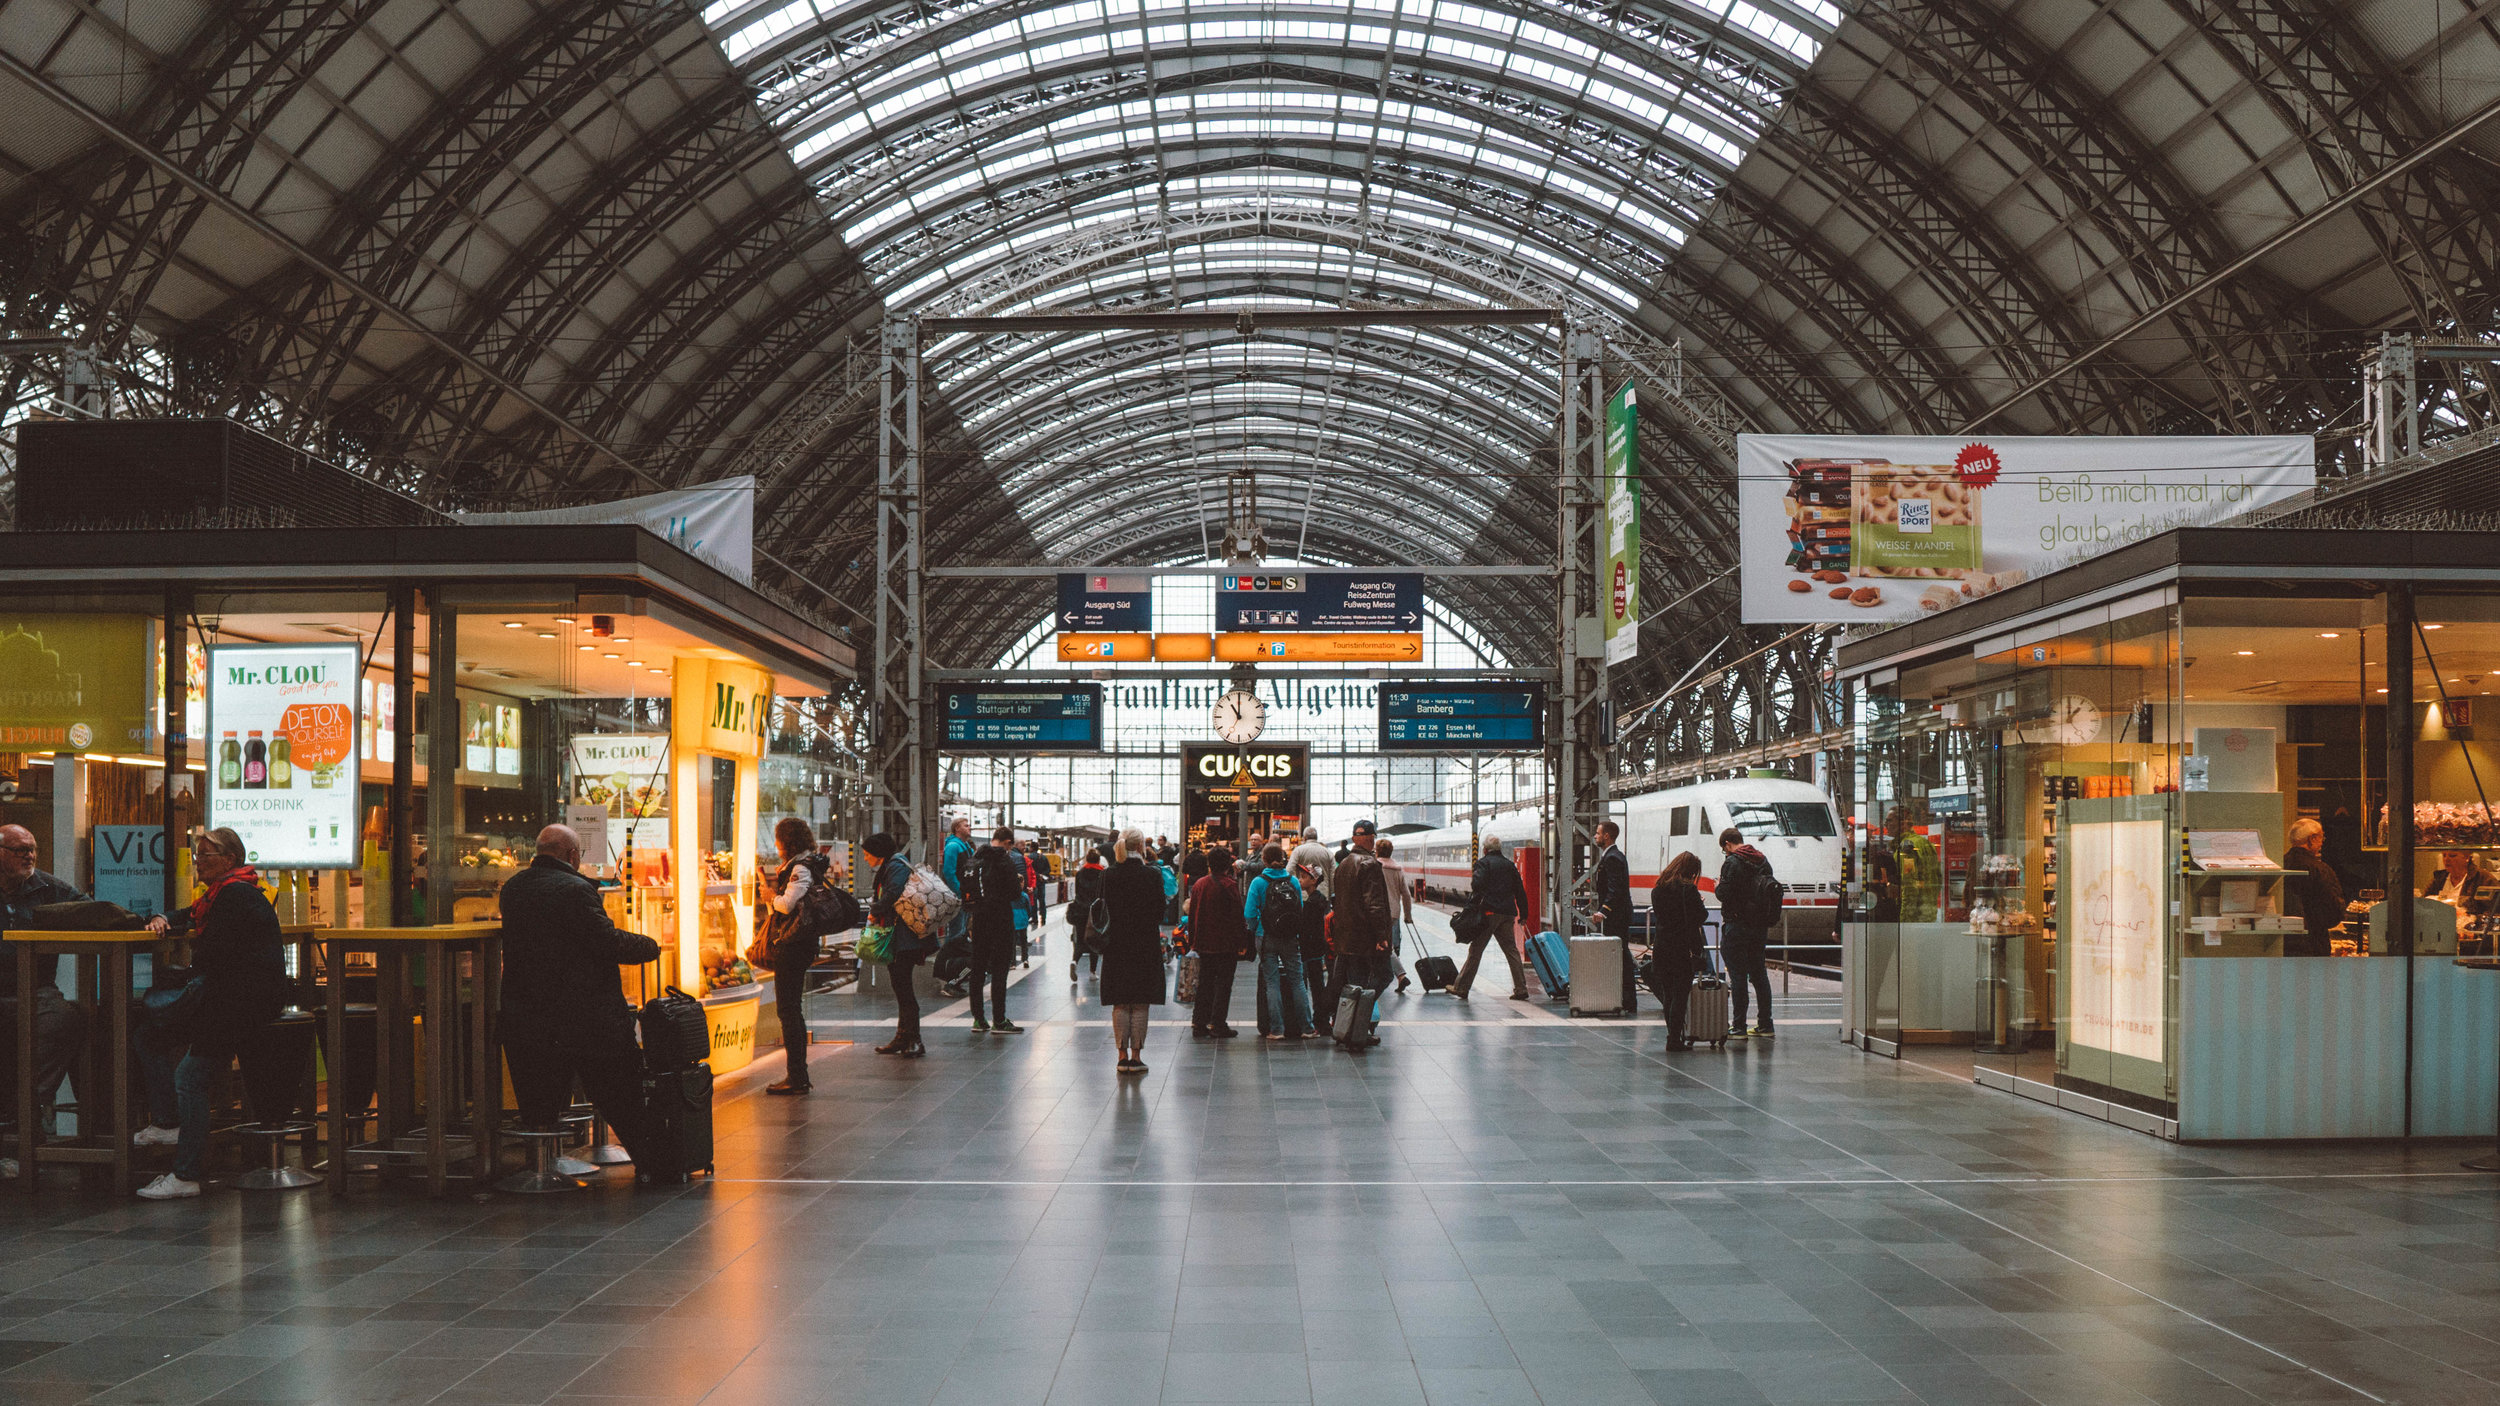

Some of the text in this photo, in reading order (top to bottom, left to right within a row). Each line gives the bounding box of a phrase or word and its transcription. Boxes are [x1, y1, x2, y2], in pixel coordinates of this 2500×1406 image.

[1962, 457, 1993, 475] NEU
[2038, 473, 2253, 507] Beiß mich mal, ich
[1900, 502, 1929, 517] Ritter
[1901, 518, 1930, 526] SPORT
[1875, 541, 1955, 551] WEISSE MANDEL
[1226, 578, 1235, 589] U
[1286, 577, 1297, 590] S
[1350, 582, 1396, 591] Ausgang City
[1085, 601, 1131, 610] Ausgang Süd
[1344, 601, 1371, 609] Fußweg
[228, 666, 326, 685] Mr. CLOU
[279, 680, 339, 696] Good for you
[710, 682, 745, 734] Mr.
[950, 695, 959, 710] 6
[1389, 693, 1533, 709] 11:30 7
[977, 705, 1032, 716] Stuttgart Hbf
[1417, 705, 1454, 715] Bamberg
[287, 704, 343, 731] DETOX
[290, 725, 345, 743] YOURSELF
[1004, 733, 1024, 741] Leipzig
[302, 748, 337, 763] enjoy life
[585, 746, 651, 760] Mr. CLOU
[215, 799, 304, 811] DETOX DRINK
[127, 867, 148, 877] frisch
[150, 868, 160, 876] im
[713, 1021, 739, 1049] frisch
